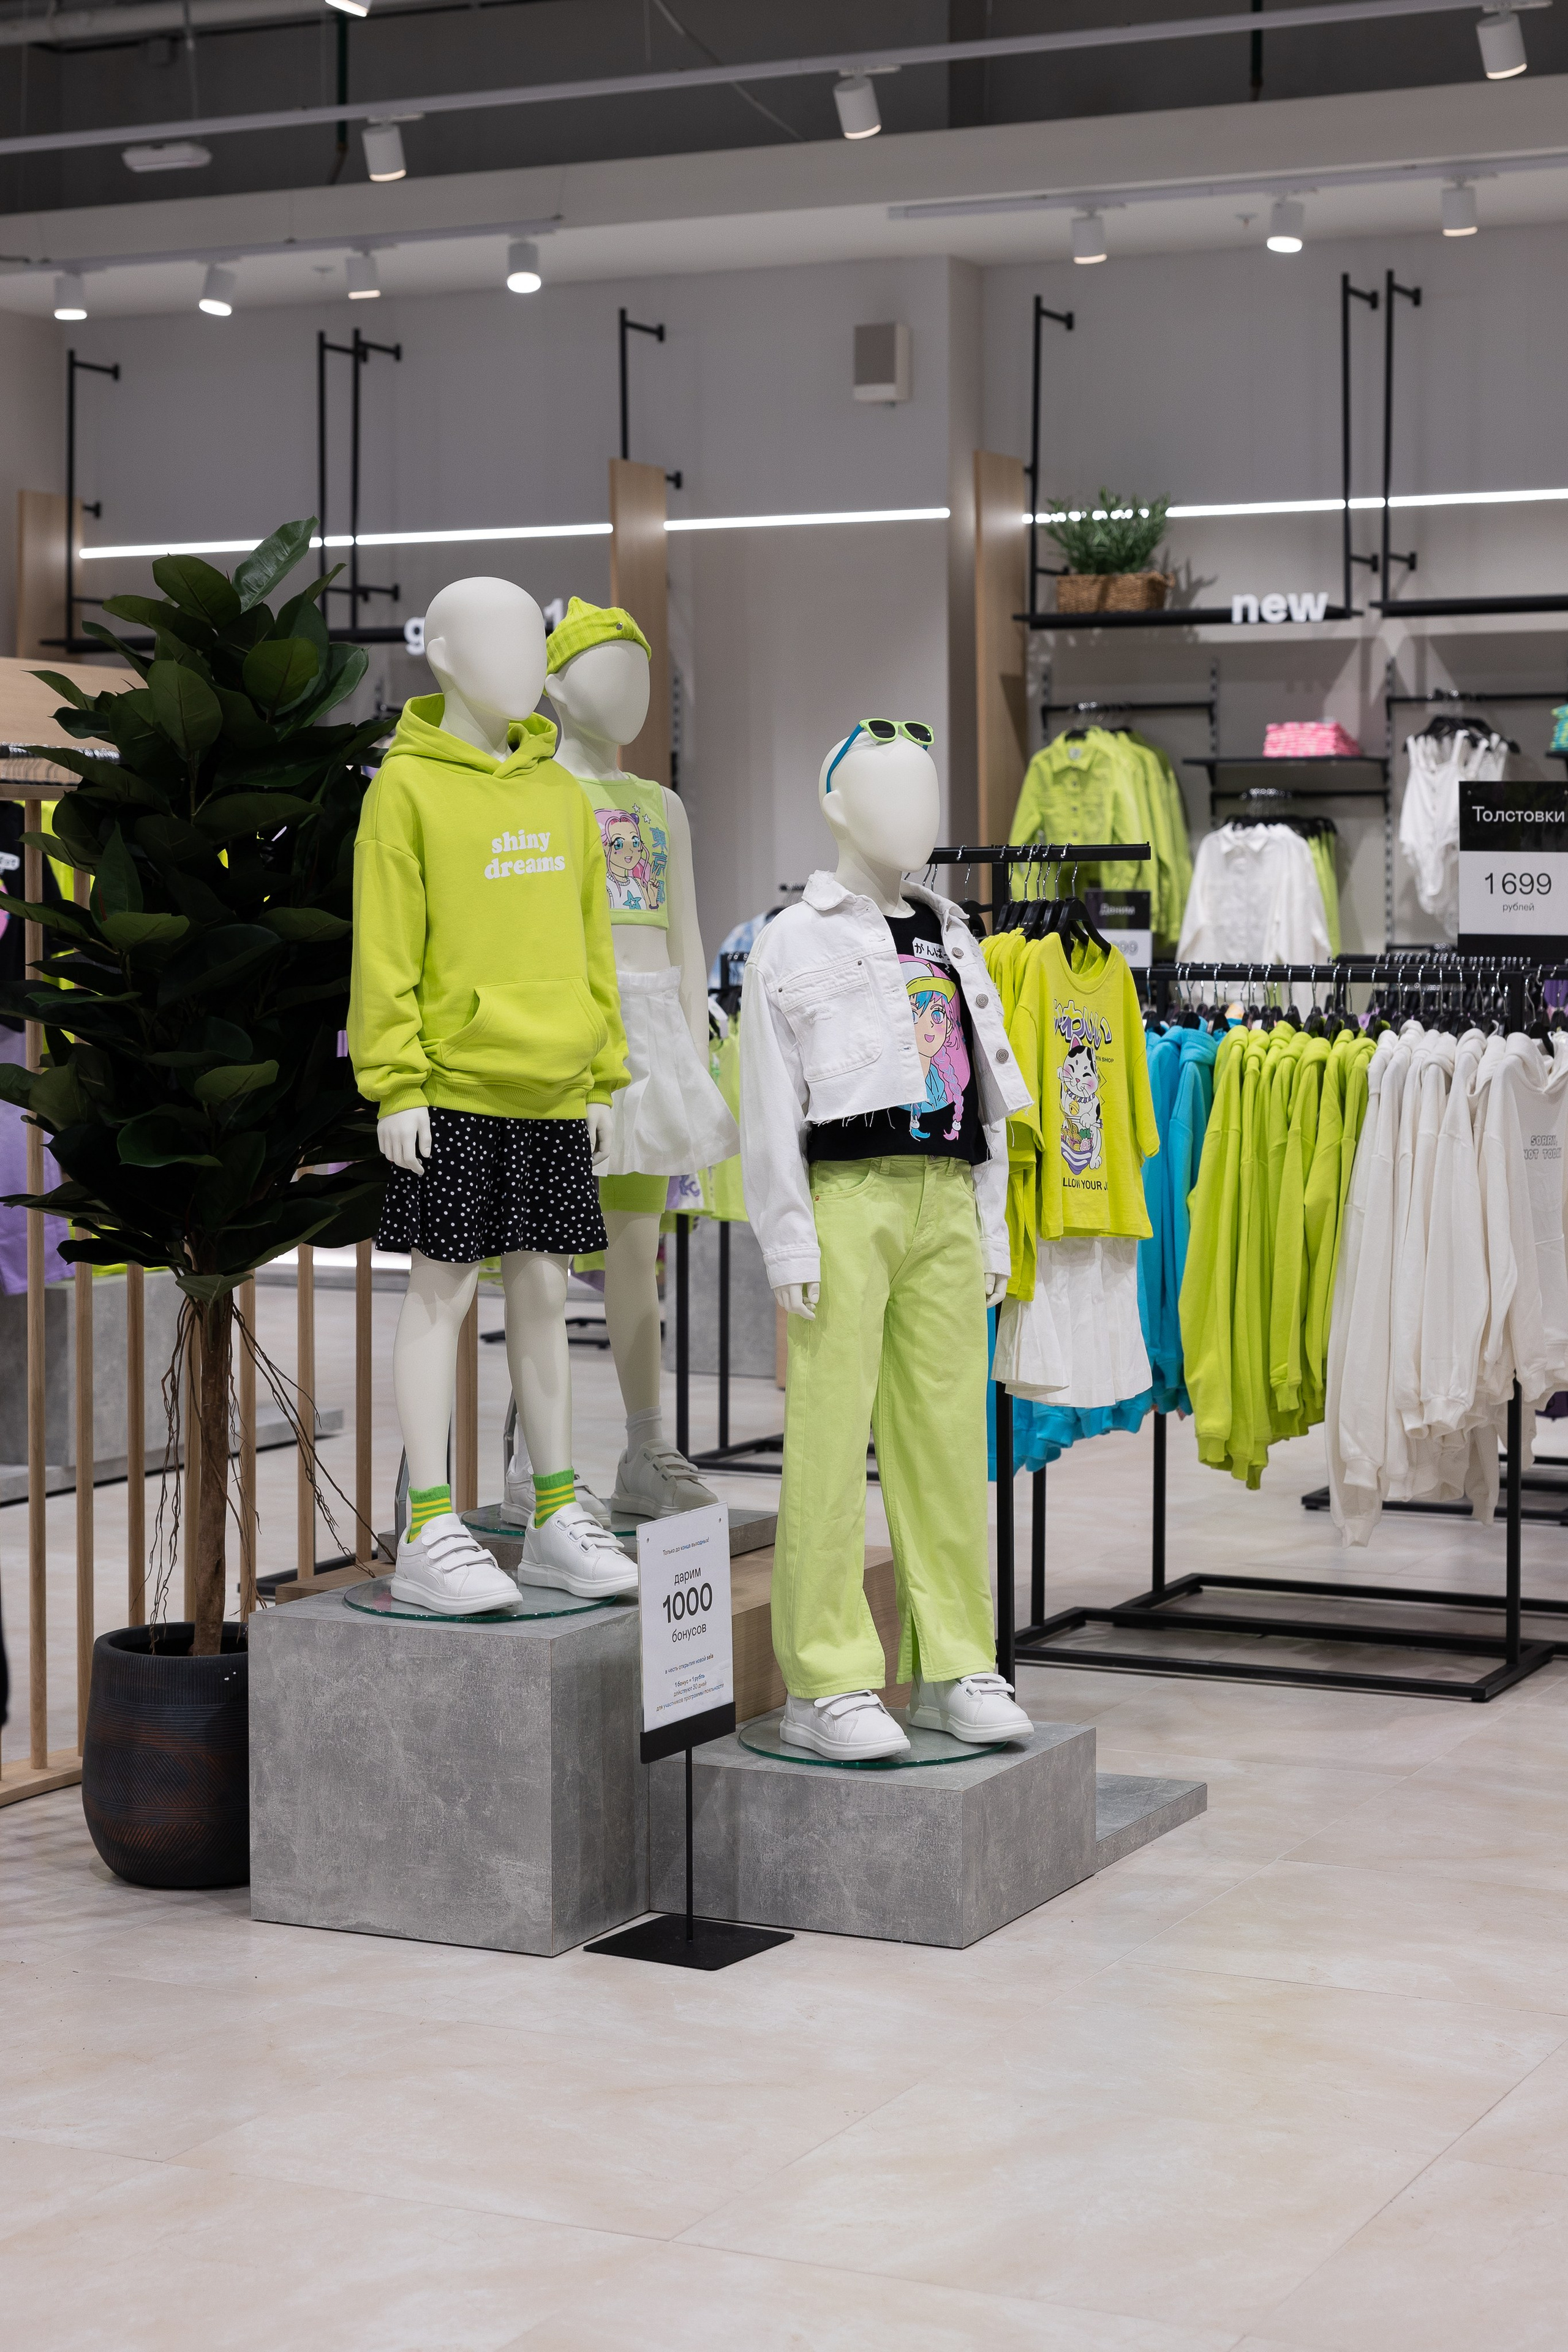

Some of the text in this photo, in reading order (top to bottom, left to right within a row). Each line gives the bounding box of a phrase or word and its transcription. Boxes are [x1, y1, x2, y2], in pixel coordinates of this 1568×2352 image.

[1231, 592, 1329, 624] new
[1472, 806, 1565, 823] Толстовки
[492, 829, 551, 853] shiny
[484, 856, 565, 880] dreams
[1502, 902, 1535, 912] рублей
[1081, 1180, 1102, 1190] YOUR
[674, 1567, 701, 1586] дарим
[663, 1583, 712, 1623] 1000
[672, 1623, 707, 1643] бонусов
[678, 1660, 695, 1670] открытия
[695, 1656, 706, 1664] новой
